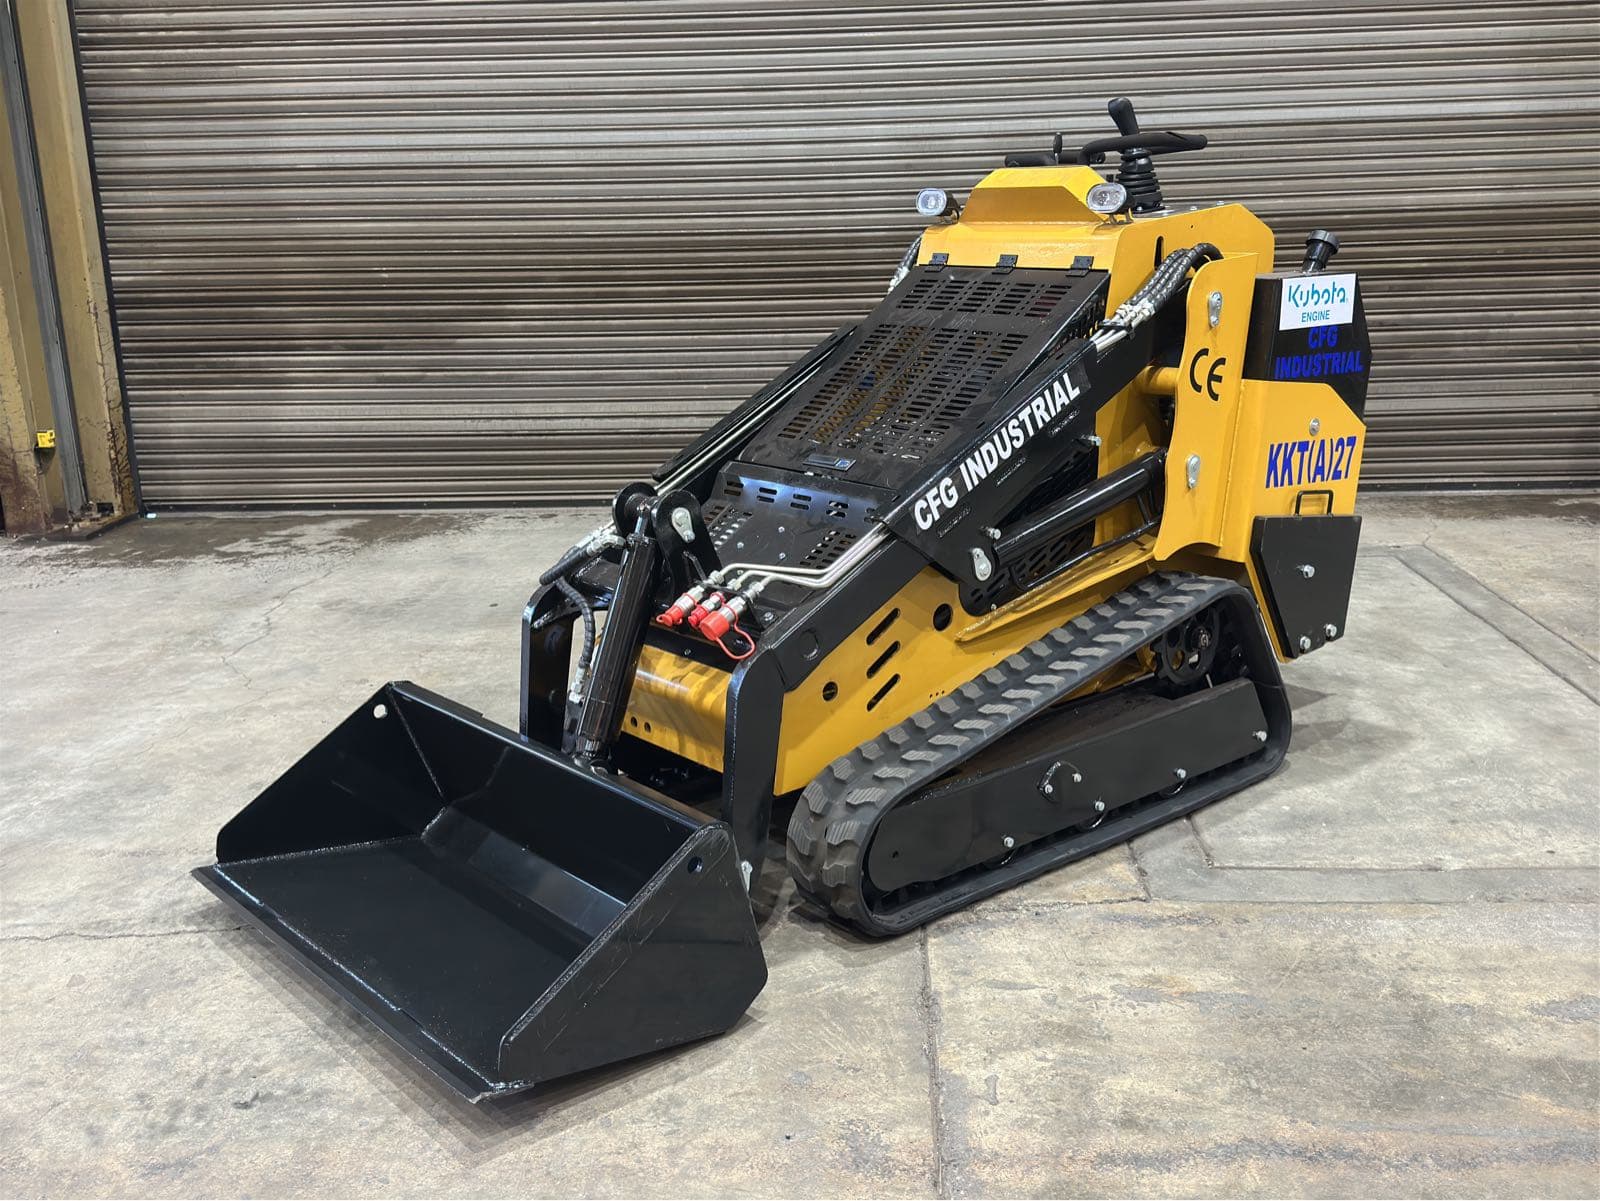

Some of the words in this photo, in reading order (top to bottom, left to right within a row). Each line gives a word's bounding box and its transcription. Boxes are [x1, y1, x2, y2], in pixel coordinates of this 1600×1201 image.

[1288, 281, 1347, 308] Kubota
[1301, 310, 1330, 323] ENGINE
[1308, 325, 1338, 348] CFG
[1190, 348, 1226, 401] CE
[1274, 351, 1364, 380] INDUSTRIAL
[914, 477, 959, 531] CFG
[958, 372, 1081, 492] INDUSTRIAL
[1265, 436, 1357, 489] KKT(A)27
